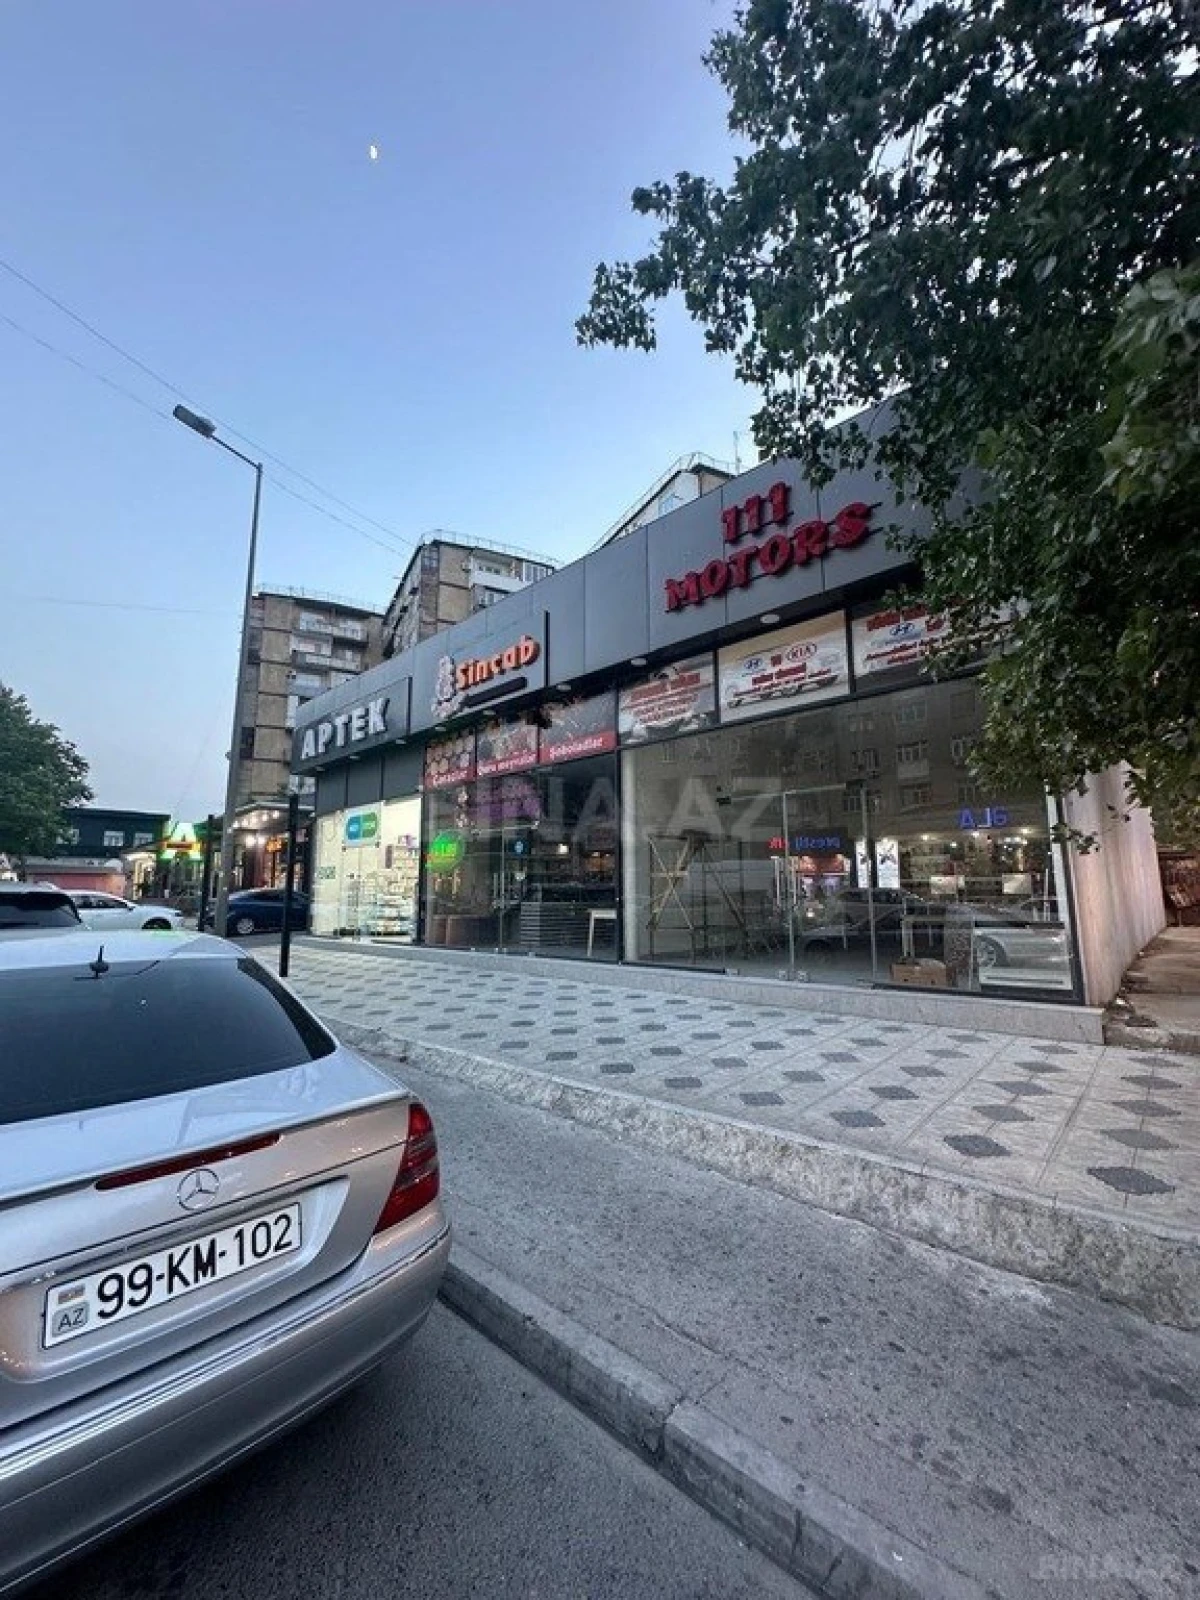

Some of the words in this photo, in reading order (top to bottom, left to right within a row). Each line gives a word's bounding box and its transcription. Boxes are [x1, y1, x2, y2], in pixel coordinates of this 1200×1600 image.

[722, 481, 792, 544] 111
[665, 501, 874, 612] MOTORS
[456, 634, 540, 690] Sincab
[300, 697, 390, 761] APTEK
[97, 1213, 293, 1320] 99-KM-102
[57, 1306, 85, 1332] AZ
